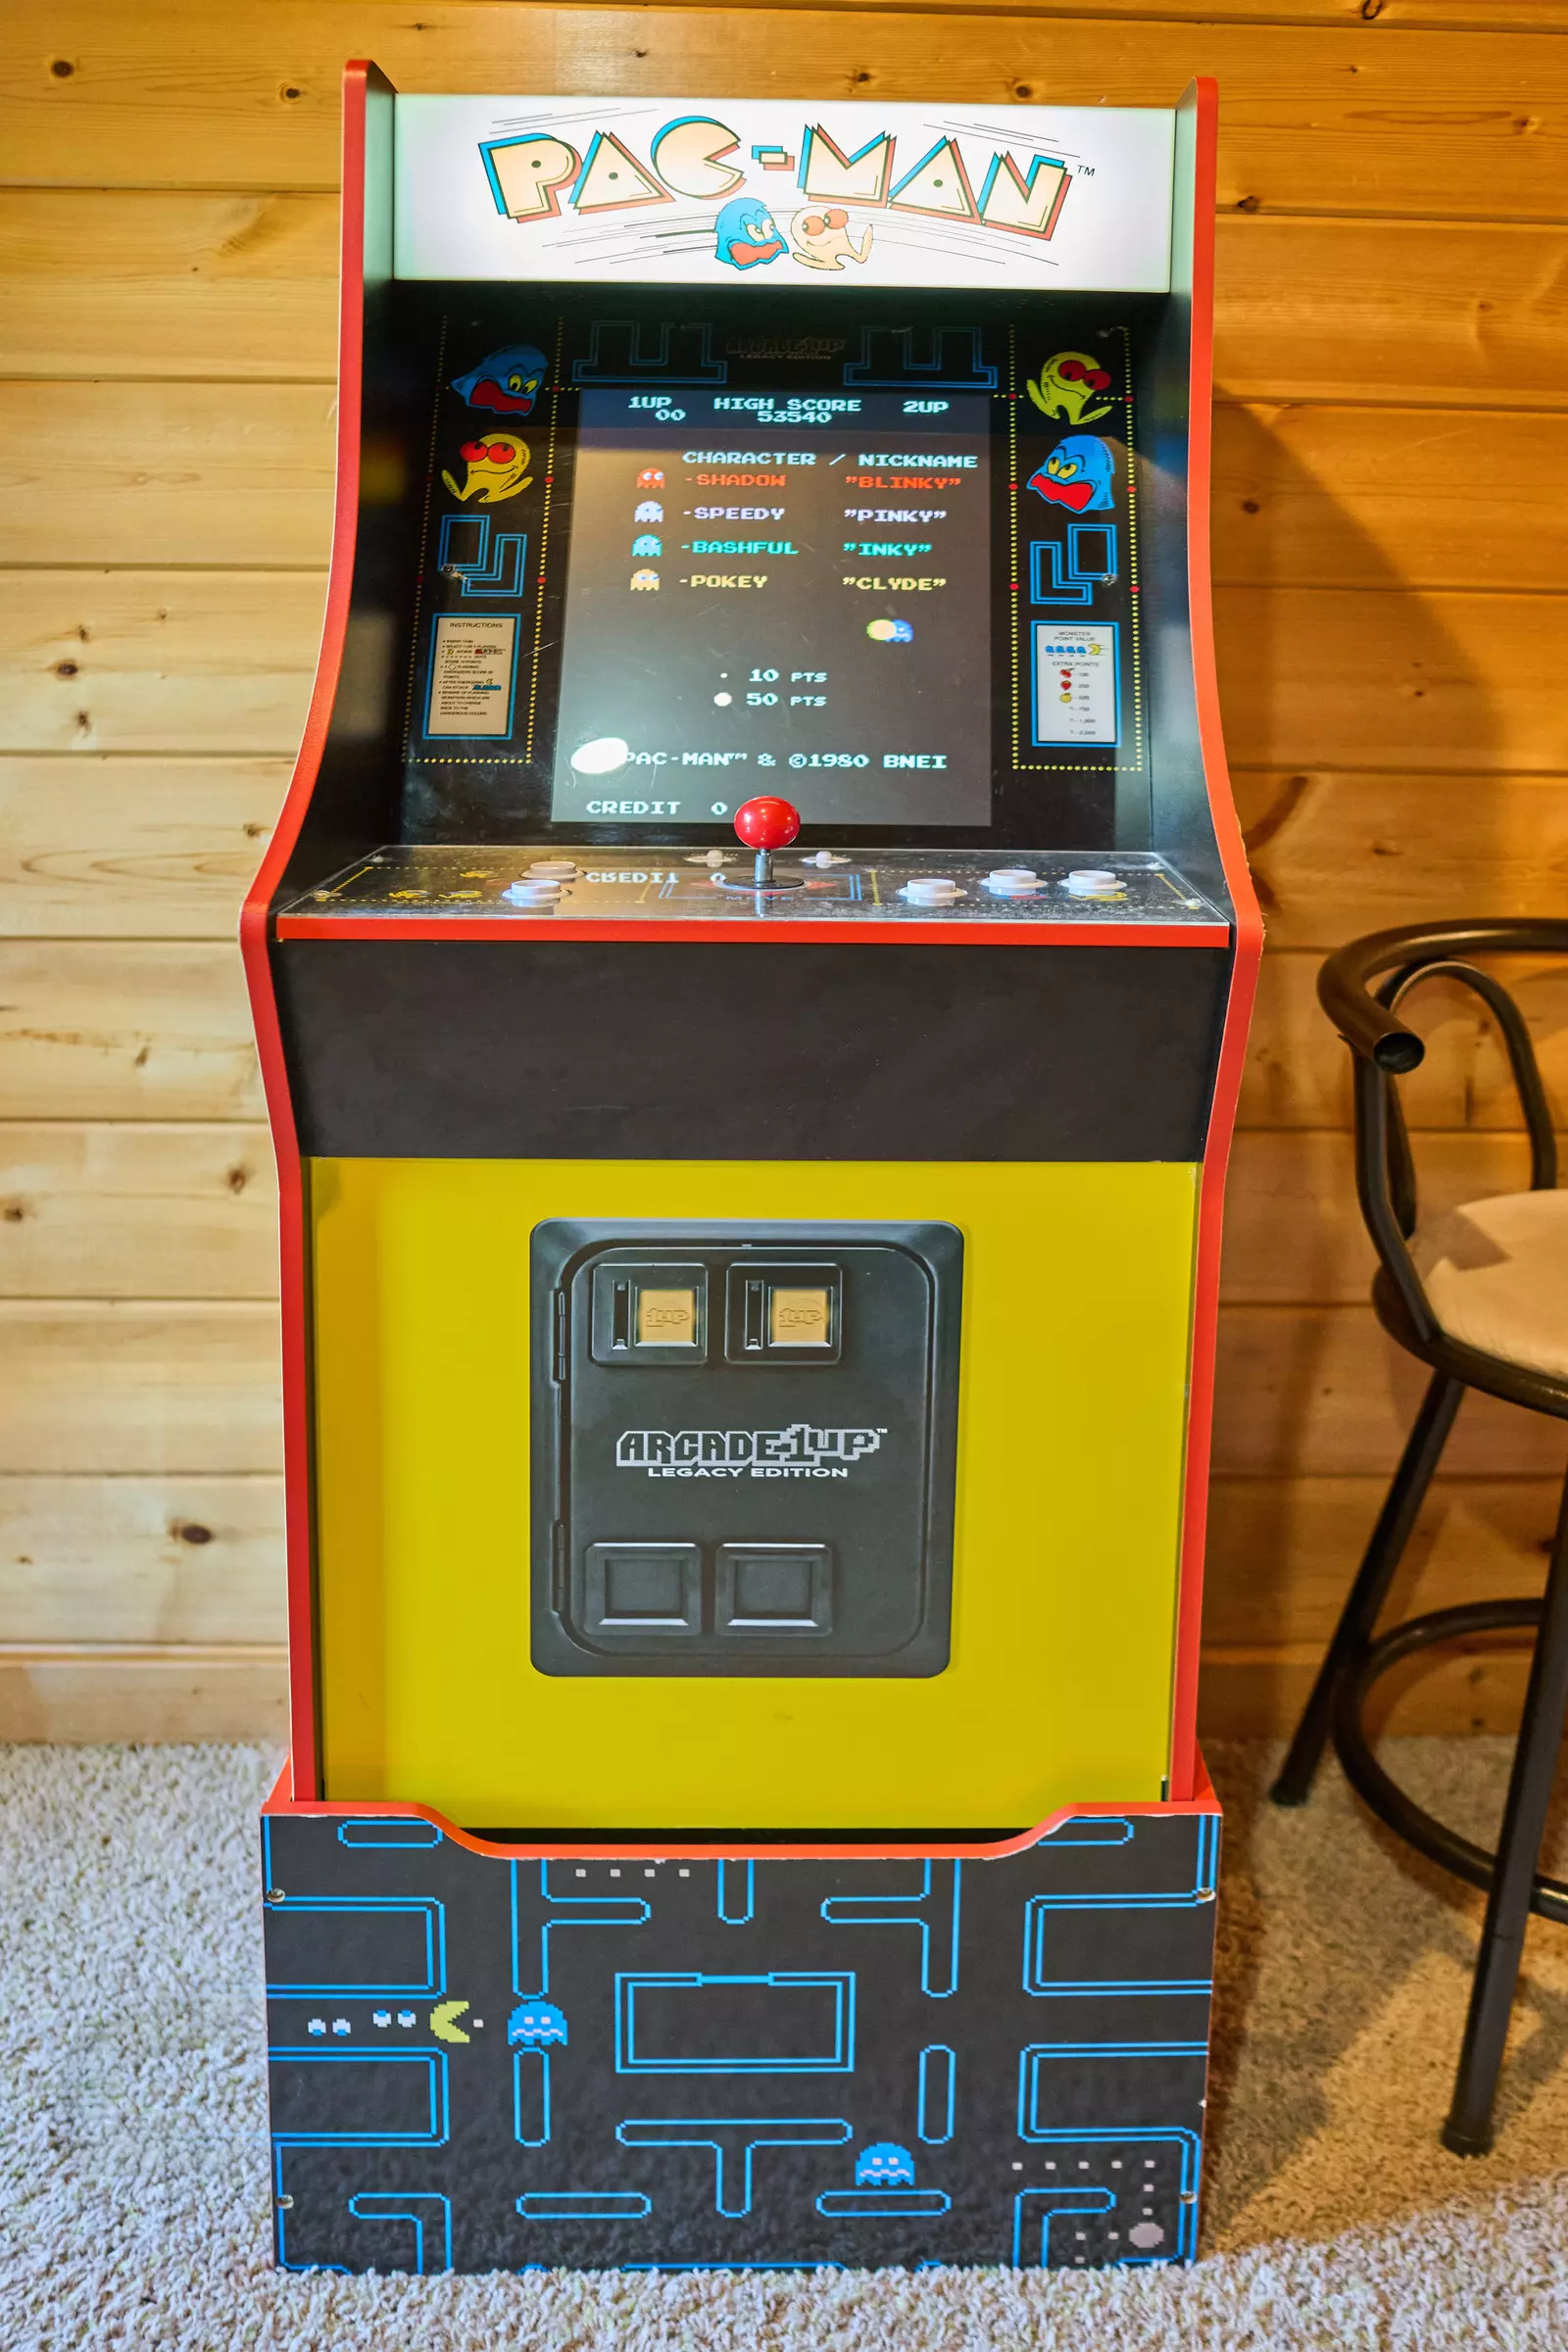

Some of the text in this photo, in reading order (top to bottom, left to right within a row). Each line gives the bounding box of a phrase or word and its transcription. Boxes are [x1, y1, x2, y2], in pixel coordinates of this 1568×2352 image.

[477, 115, 1072, 241] PAC-MAN
[627, 396, 950, 414] 1UP HIGH SCORE 2UP
[655, 409, 832, 424] 00 53540
[682, 451, 816, 466] CHARACTER
[858, 454, 978, 469] NICKNAME
[749, 668, 827, 683] 10 PTS
[746, 692, 827, 707] 50 PTS
[758, 754, 776, 767] &
[883, 755, 948, 768] BNEI
[586, 801, 728, 814] CREDIT 0
[648, 1468, 848, 1478] LEGACY EDITION
